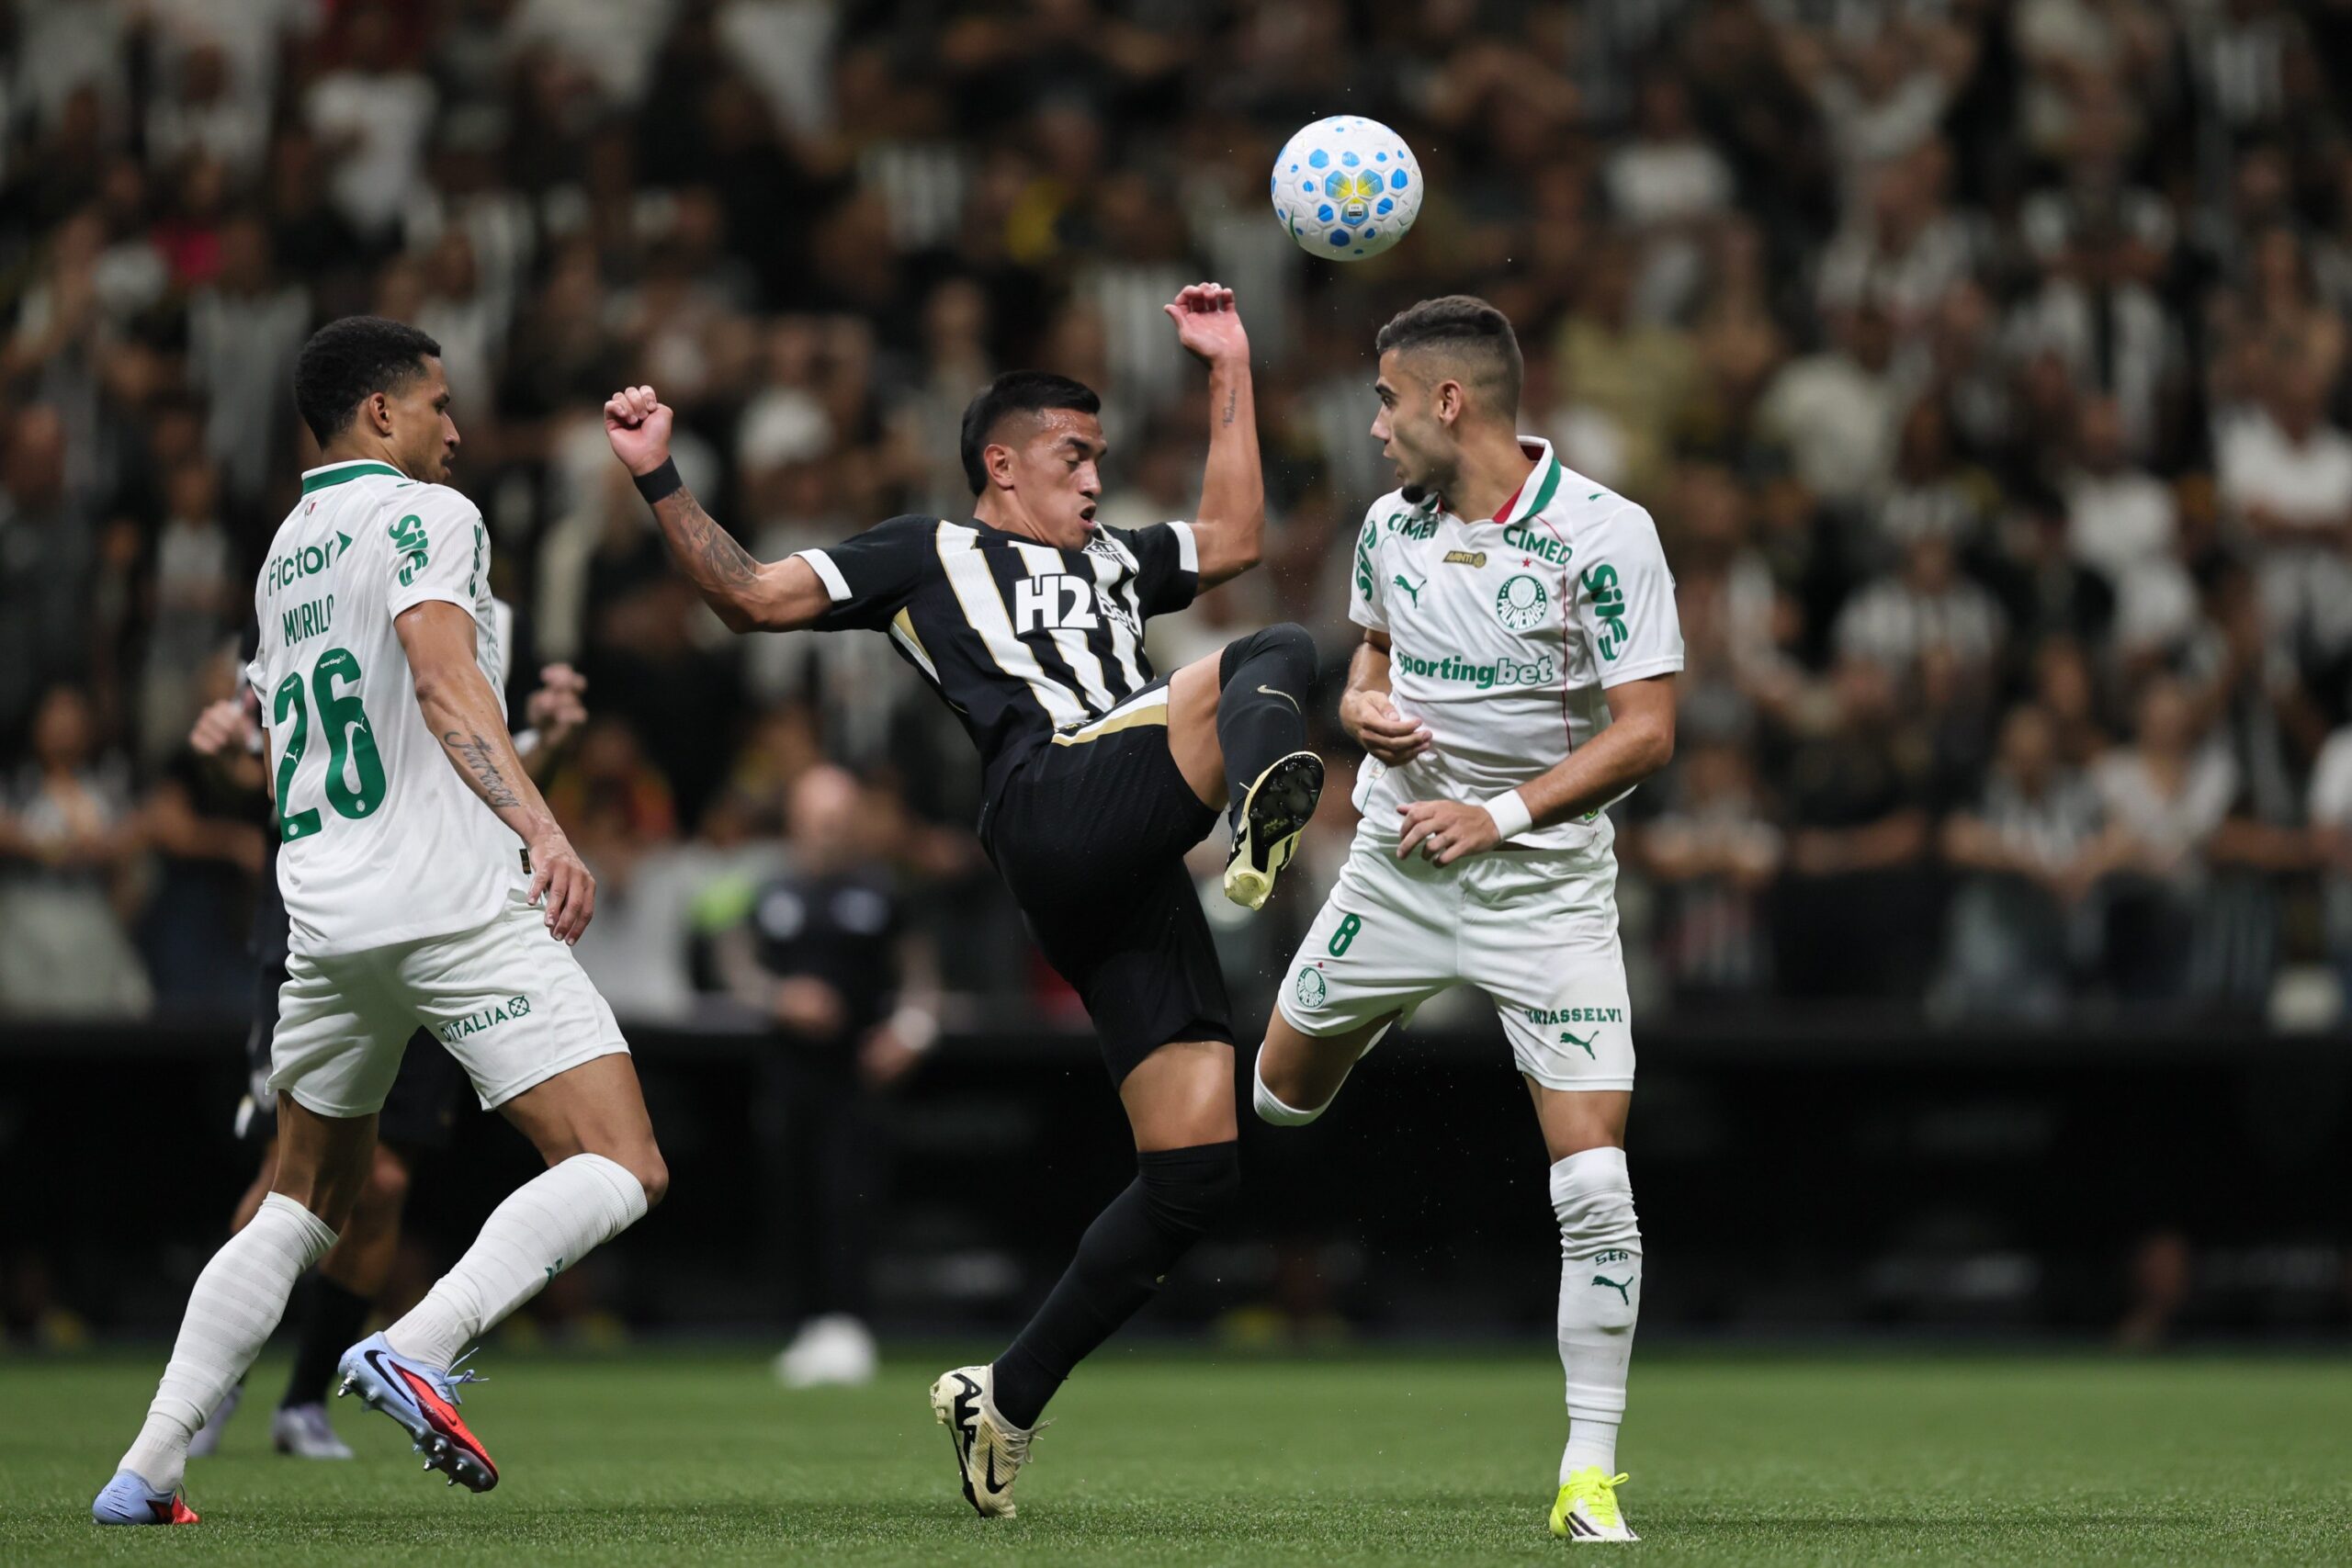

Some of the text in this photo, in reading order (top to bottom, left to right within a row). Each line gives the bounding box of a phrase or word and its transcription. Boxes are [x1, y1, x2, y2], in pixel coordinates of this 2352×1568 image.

[1503, 526, 1573, 566] CIMED
[268, 539, 334, 597] Fictor
[1498, 598, 1546, 630] PALMEIRAS
[1396, 651, 1553, 689] sportingbet
[274, 648, 386, 843] 26
[1329, 913, 1362, 957] 8
